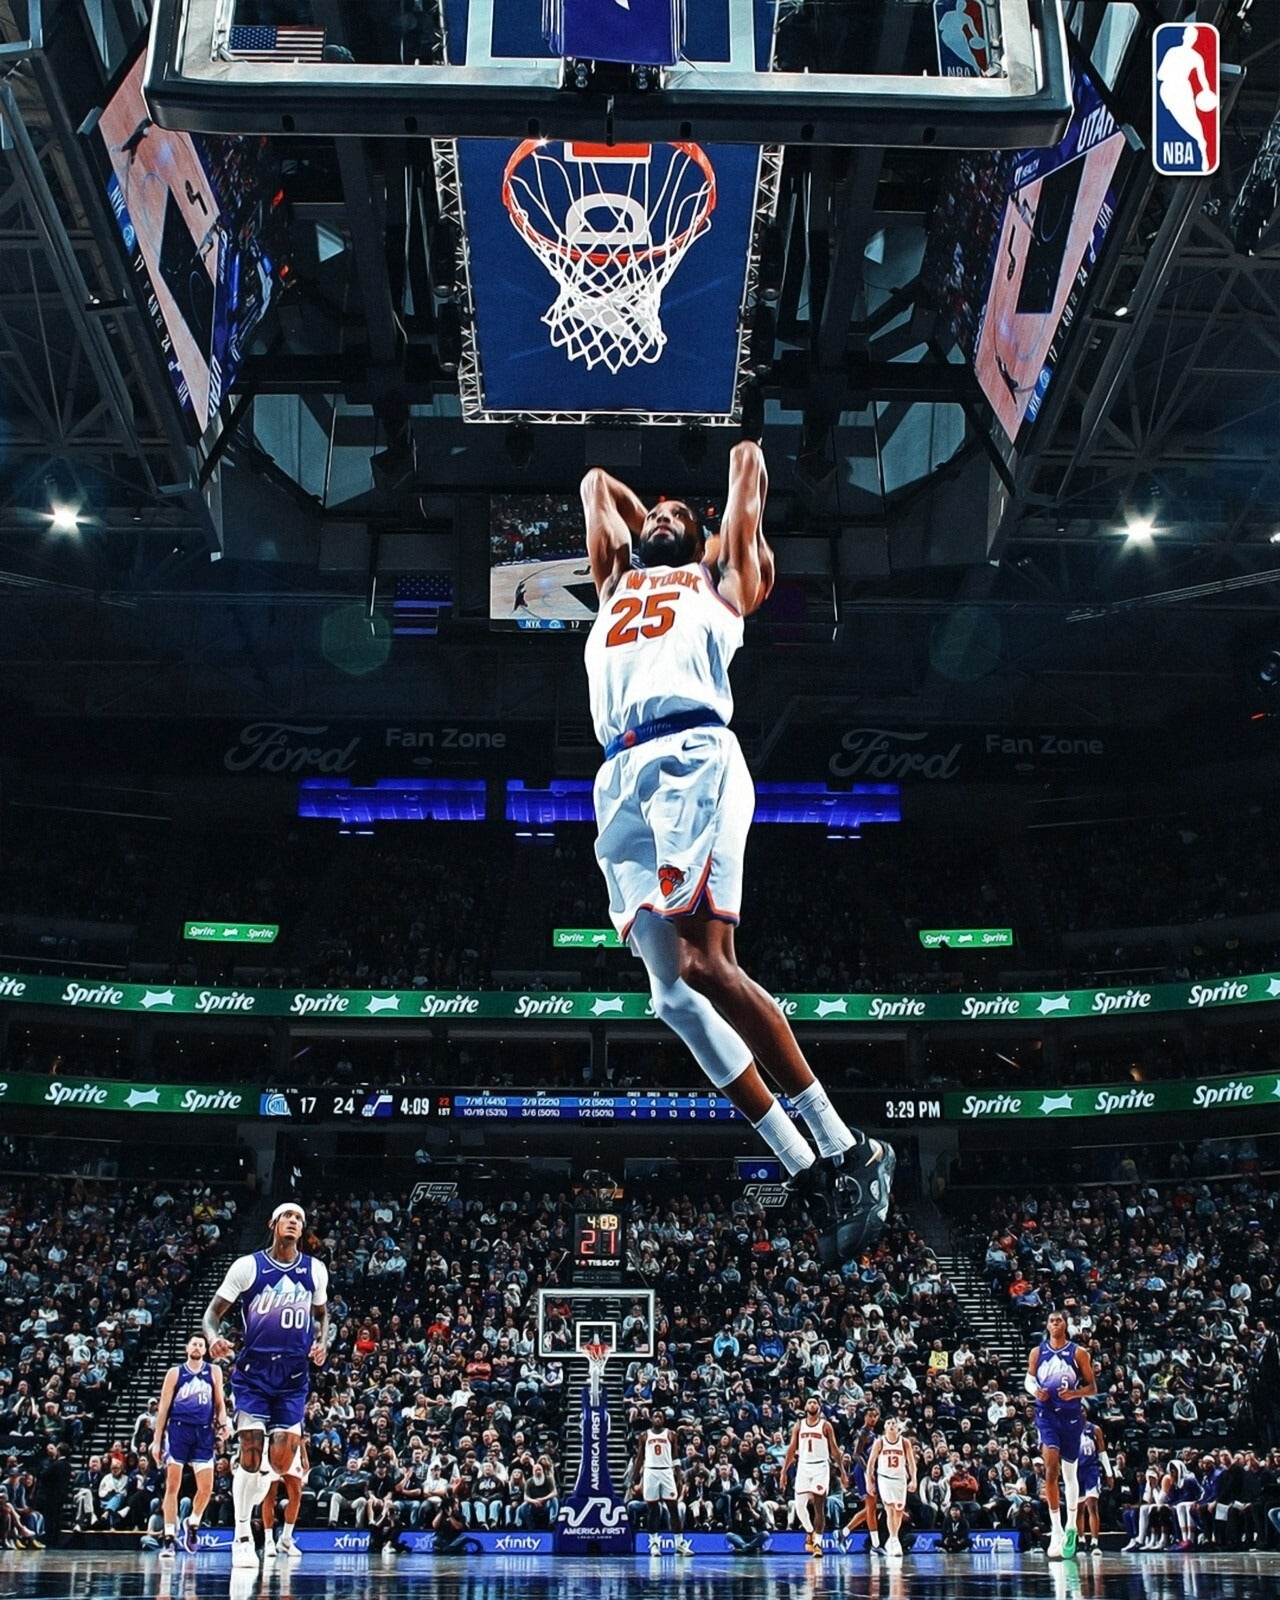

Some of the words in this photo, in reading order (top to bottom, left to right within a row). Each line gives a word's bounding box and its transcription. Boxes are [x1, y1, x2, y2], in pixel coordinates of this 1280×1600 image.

[1097, 202, 1114, 229] UTA
[525, 620, 541, 628] NYK
[605, 592, 680, 647] 25
[386, 728, 434, 748] Fan
[442, 728, 506, 748] Zone
[986, 734, 1033, 754] Fan
[1040, 735, 1104, 755] Zone
[224, 722, 362, 773] Ford
[829, 728, 963, 779] Ford
[188, 926, 216, 937] Sprite
[247, 928, 274, 939] Sprite
[558, 933, 585, 944] Sprite
[982, 933, 1008, 944] Sprite
[0, 976, 26, 996] ite
[62, 982, 124, 1006] Sprite
[195, 991, 256, 1013] Sprite
[290, 993, 349, 1016] Sprite
[420, 994, 479, 1017] Sprite
[514, 995, 574, 1018] Sprite
[868, 997, 926, 1019] Sprite
[961, 996, 1020, 1019] Sprite
[1091, 989, 1152, 1014] Sprite
[1188, 981, 1249, 1007] Sprite
[45, 1082, 108, 1105] Sprite
[180, 1089, 242, 1112] Sprite
[438, 1097, 450, 1105] 22
[522, 1098, 537, 1106] 2/9
[579, 1098, 591, 1106] 1/2
[592, 1098, 615, 1107] (50%)
[630, 1099, 637, 1107] 0
[690, 1099, 696, 1107] 3
[709, 1099, 716, 1107] 0
[962, 1094, 1022, 1118] Sprite
[1095, 1088, 1155, 1114] Sprite
[1192, 1081, 1254, 1108] Sprite
[300, 1097, 317, 1114] 17
[333, 1097, 355, 1114] 24
[400, 1097, 429, 1115] 4:09
[438, 1108, 451, 1116] 1ST
[463, 1108, 484, 1116] 10/19
[485, 1108, 508, 1117] (53%)
[521, 1109, 536, 1117] 3/6
[537, 1108, 560, 1117] (50%)
[579, 1109, 591, 1117] 1/2
[592, 1109, 615, 1117] (50%)
[690, 1110, 696, 1118] 6
[709, 1110, 716, 1118] 0
[886, 1101, 915, 1118] 3:29
[919, 1101, 941, 1118] PM
[413, 1185, 427, 1202] 5
[587, 1215, 617, 1230] 4:09
[588, 1259, 620, 1267] TISSOT
[257, 1290, 309, 1315] UTAH
[281, 1308, 305, 1329] 00
[1061, 1376, 1069, 1390] 5
[198, 1393, 208, 1405] 15
[591, 1411, 600, 1439] FIRST
[808, 1439, 813, 1452] 1
[1083, 1446, 1092, 1456] 13
[591, 1442, 600, 1490] AMERICA
[888, 1456, 899, 1468] 13
[563, 1527, 600, 1535] AMERICA
[602, 1527, 626, 1535] FIRST
[334, 1533, 370, 1549] xfinit
[495, 1535, 541, 1550] xfinity
